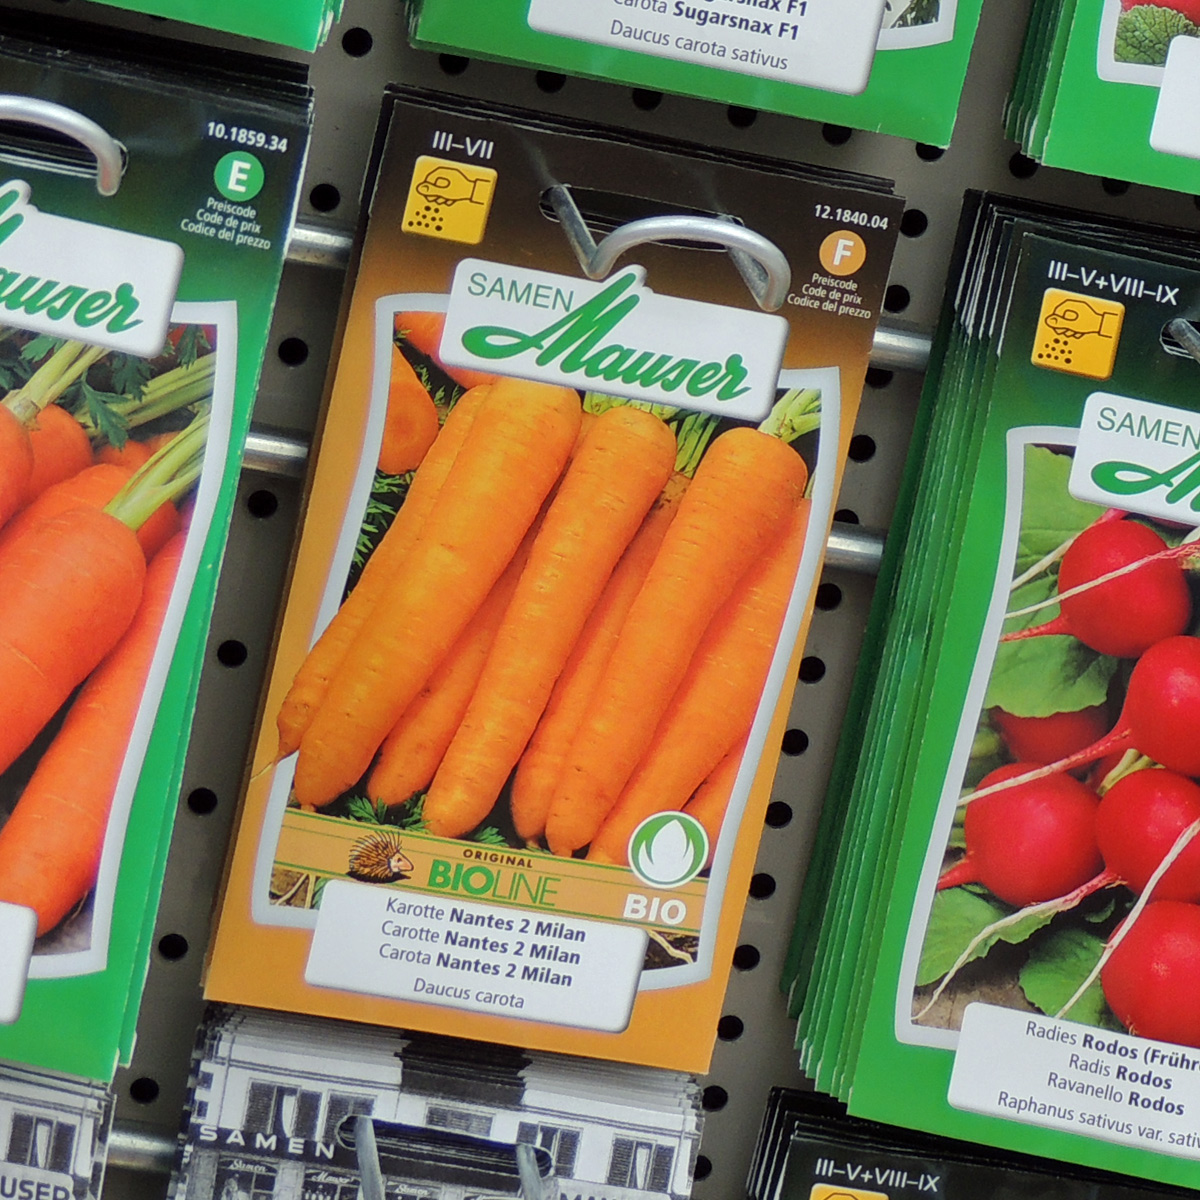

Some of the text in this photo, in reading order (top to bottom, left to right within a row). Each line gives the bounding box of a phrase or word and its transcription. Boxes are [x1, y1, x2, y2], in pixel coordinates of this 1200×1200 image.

[672, 0, 773, 36] Sugarsnax
[777, 21, 799, 41] F1
[610, 19, 788, 70] Daucus carota sativus
[206, 122, 288, 153] 10.1859.34
[227, 160, 251, 193] E
[195, 207, 261, 234] Code de prix
[205, 196, 257, 219] Preiscode
[814, 204, 888, 230] 12.1840.04
[179, 217, 271, 250] Codice del prezzo
[833, 238, 855, 266] F
[467, 272, 574, 312] SAMEN
[462, 272, 753, 401] Mauser
[462, 848, 533, 869] ORIGINAL
[427, 859, 561, 907] BIOLINE
[385, 896, 586, 943] Karotte Nantes 2 Milan
[623, 893, 687, 925] BIO
[378, 942, 572, 987] Carota Nantes 2 Milan
[413, 977, 524, 1009] Daucus carota
[1025, 1020, 1077, 1045] Radies
[1081, 1032, 1138, 1060] Rodos
[1068, 1053, 1172, 1090] Radis Rodos
[1047, 1071, 1185, 1116] Ravanello Rodos
[997, 1090, 1074, 1121] Raphanus
[1078, 1111, 1133, 1135] sativus
[1137, 1125, 1163, 1142] var.
[199, 1124, 335, 1159] SAMEN
